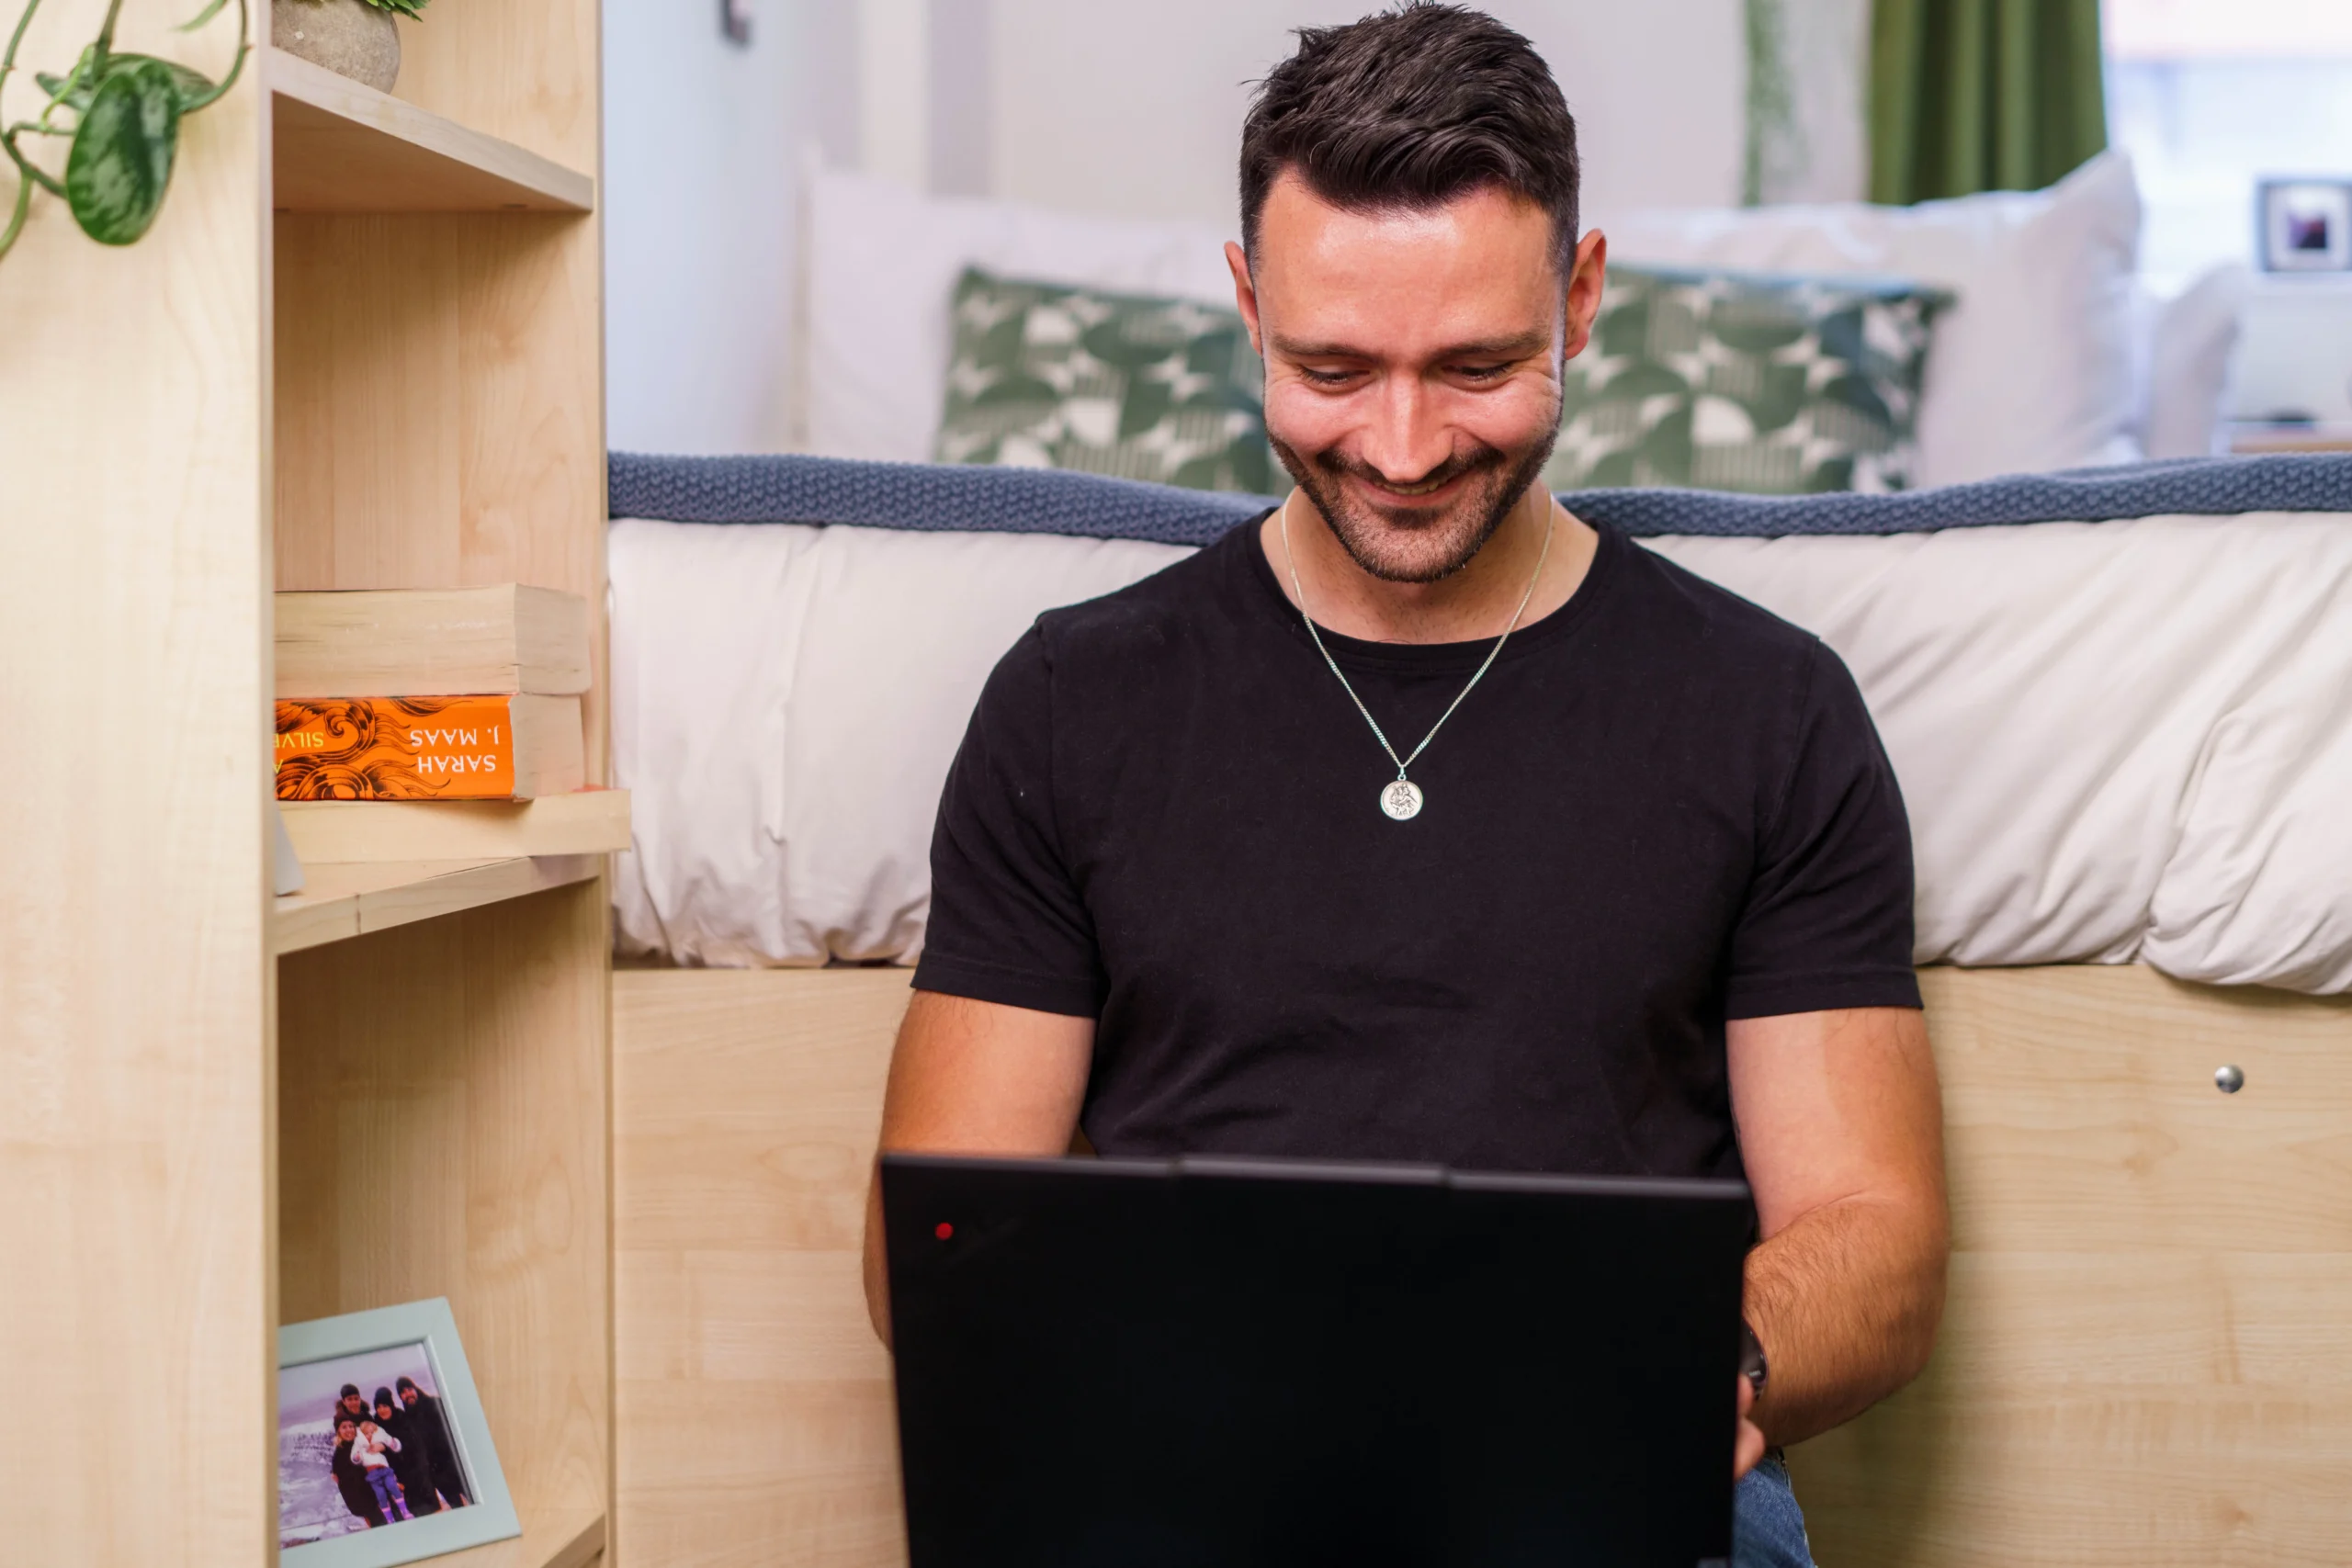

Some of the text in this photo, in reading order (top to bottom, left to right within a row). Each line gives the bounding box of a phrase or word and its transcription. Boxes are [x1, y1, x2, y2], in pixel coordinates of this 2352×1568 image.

[410, 724, 499, 747] J. MAAS
[418, 754, 496, 773] SARAH
